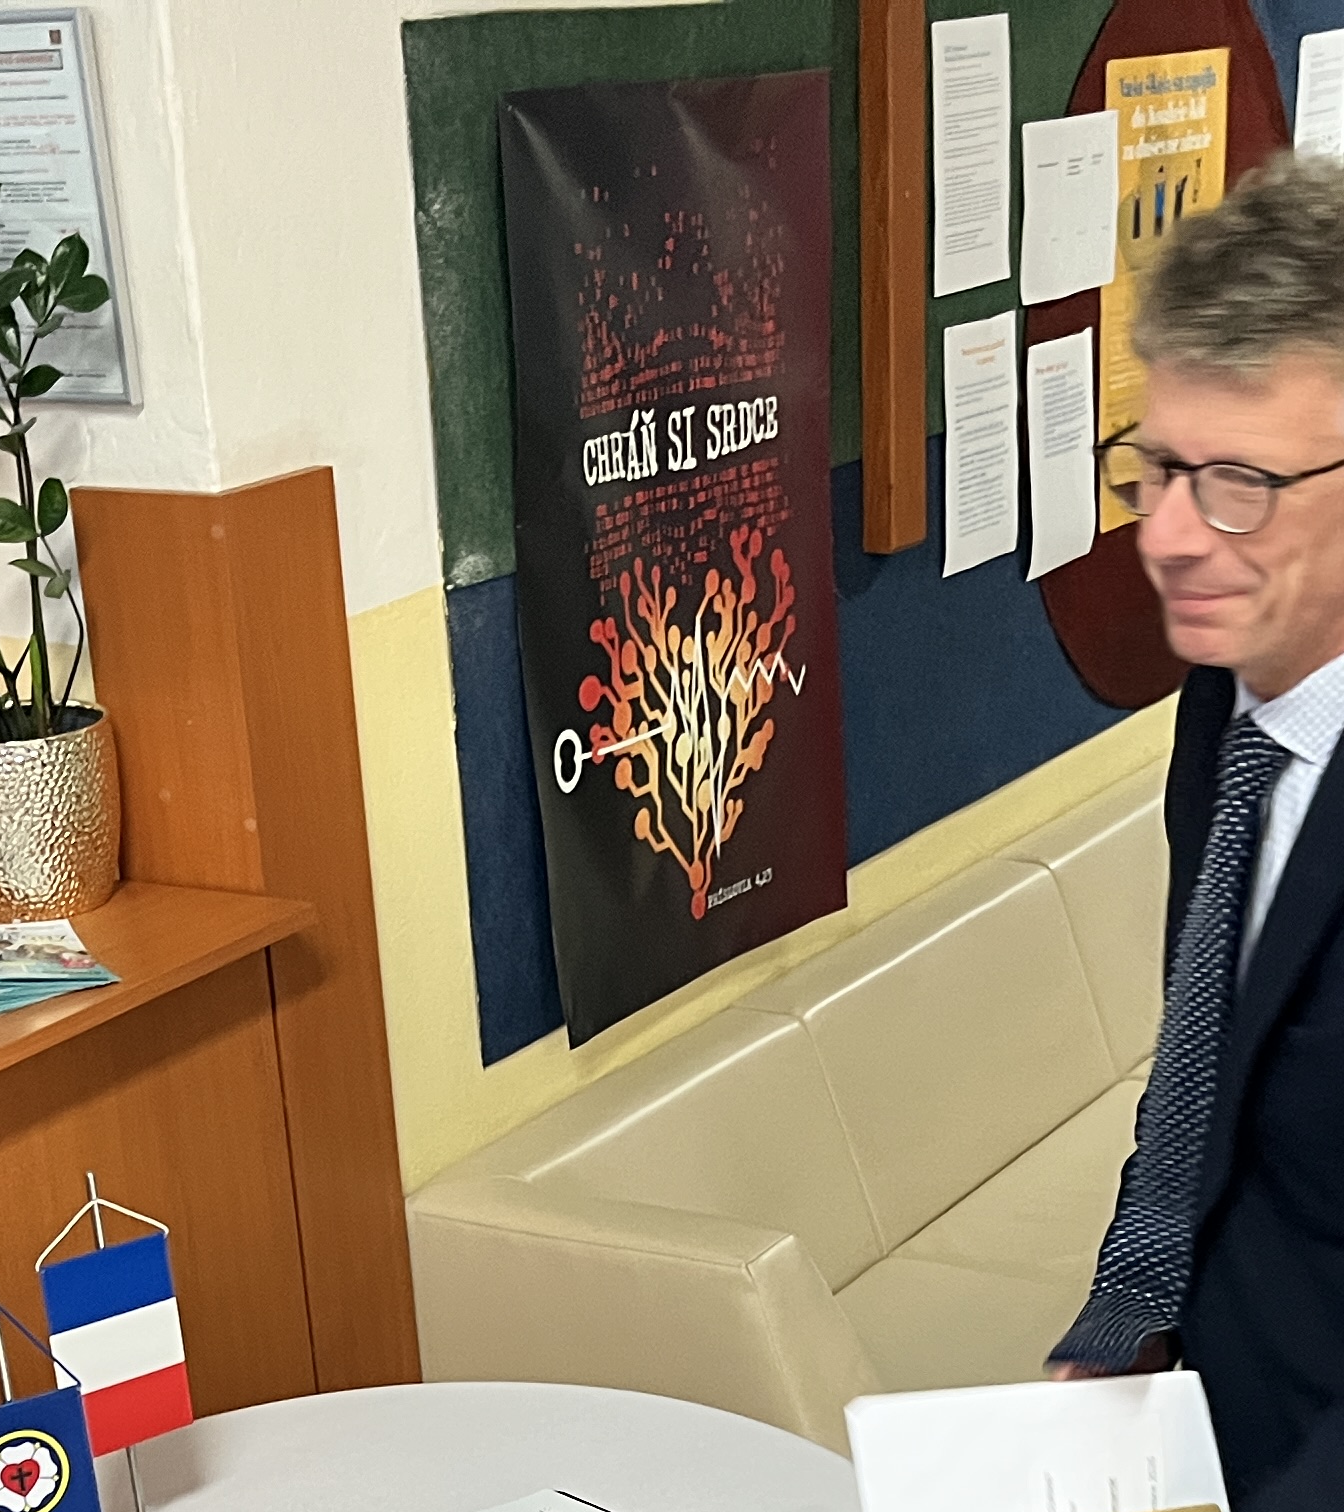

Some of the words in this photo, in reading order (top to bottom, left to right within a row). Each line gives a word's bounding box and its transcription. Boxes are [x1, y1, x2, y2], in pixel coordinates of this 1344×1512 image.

[583, 408, 658, 487] CHRÁŇ
[668, 406, 697, 471] SI
[706, 396, 778, 460] SRDCE
